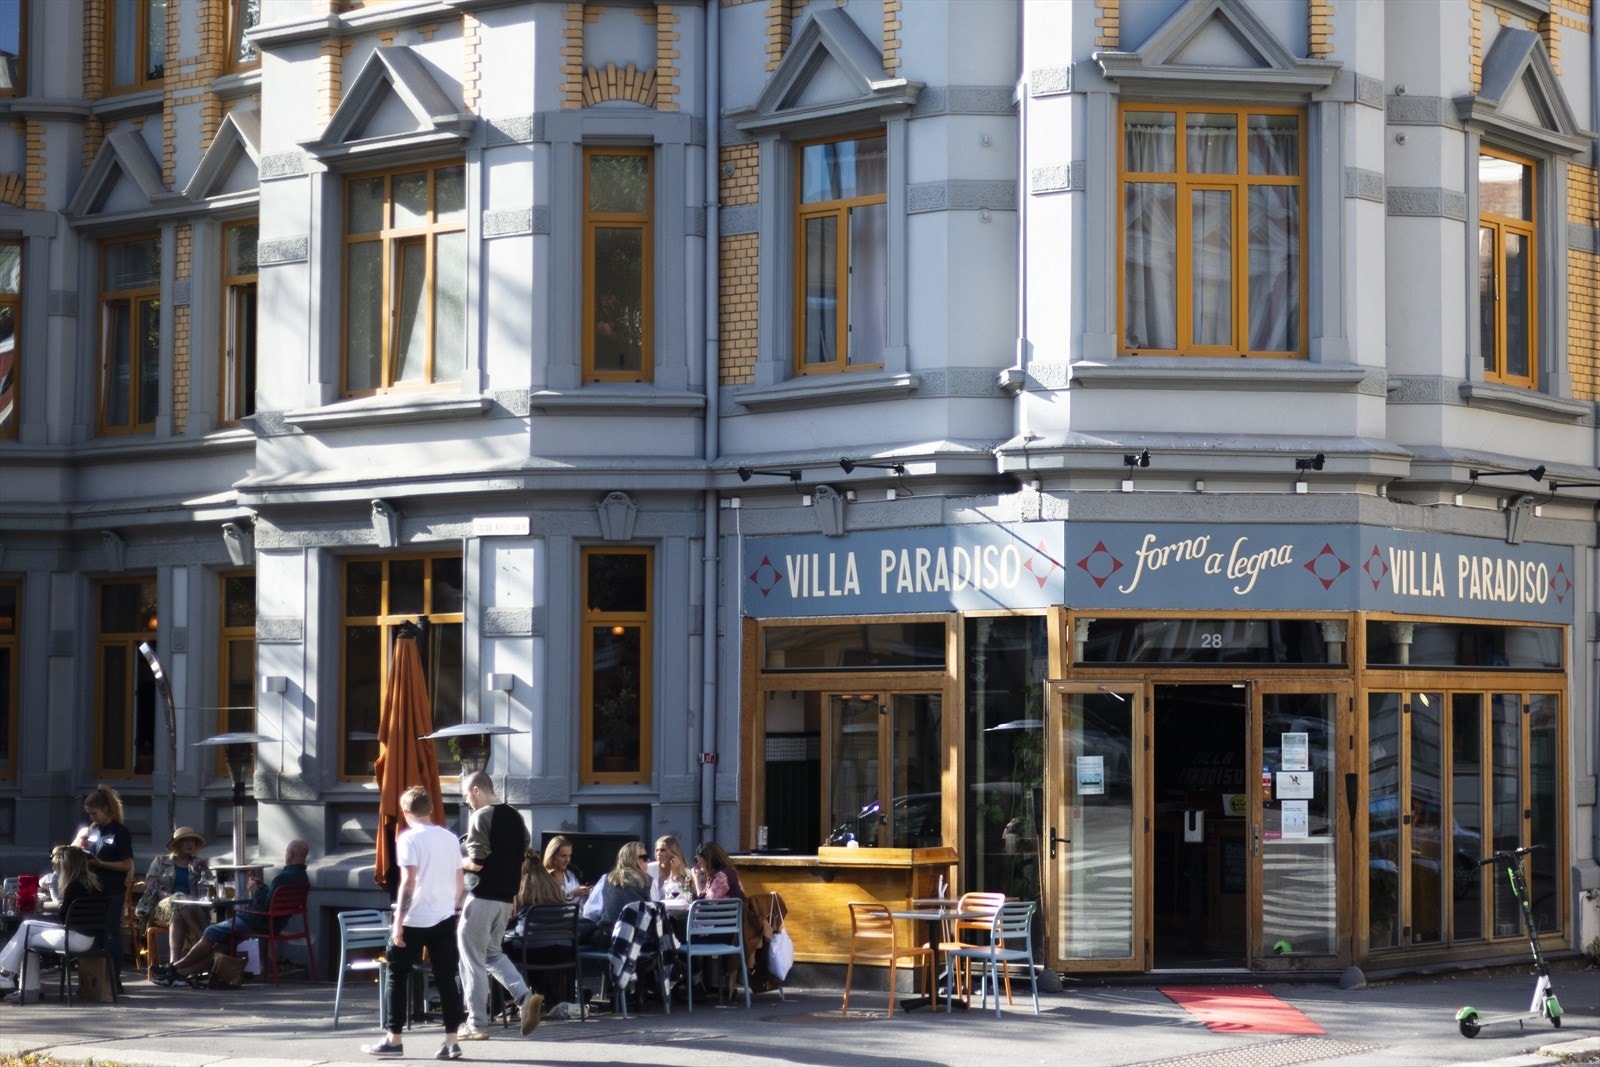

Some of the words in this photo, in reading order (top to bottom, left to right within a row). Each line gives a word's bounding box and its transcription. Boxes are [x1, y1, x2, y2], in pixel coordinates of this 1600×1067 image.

[785, 551, 861, 599] VILLA
[880, 543, 1021, 594] PARADISO
[1118, 534, 1211, 594] forno
[1204, 552, 1225, 575] a
[1226, 536, 1294, 595] legna
[1388, 547, 1446, 598] VILLA
[1458, 554, 1549, 605] PARADISO
[1201, 633, 1222, 649] 28
